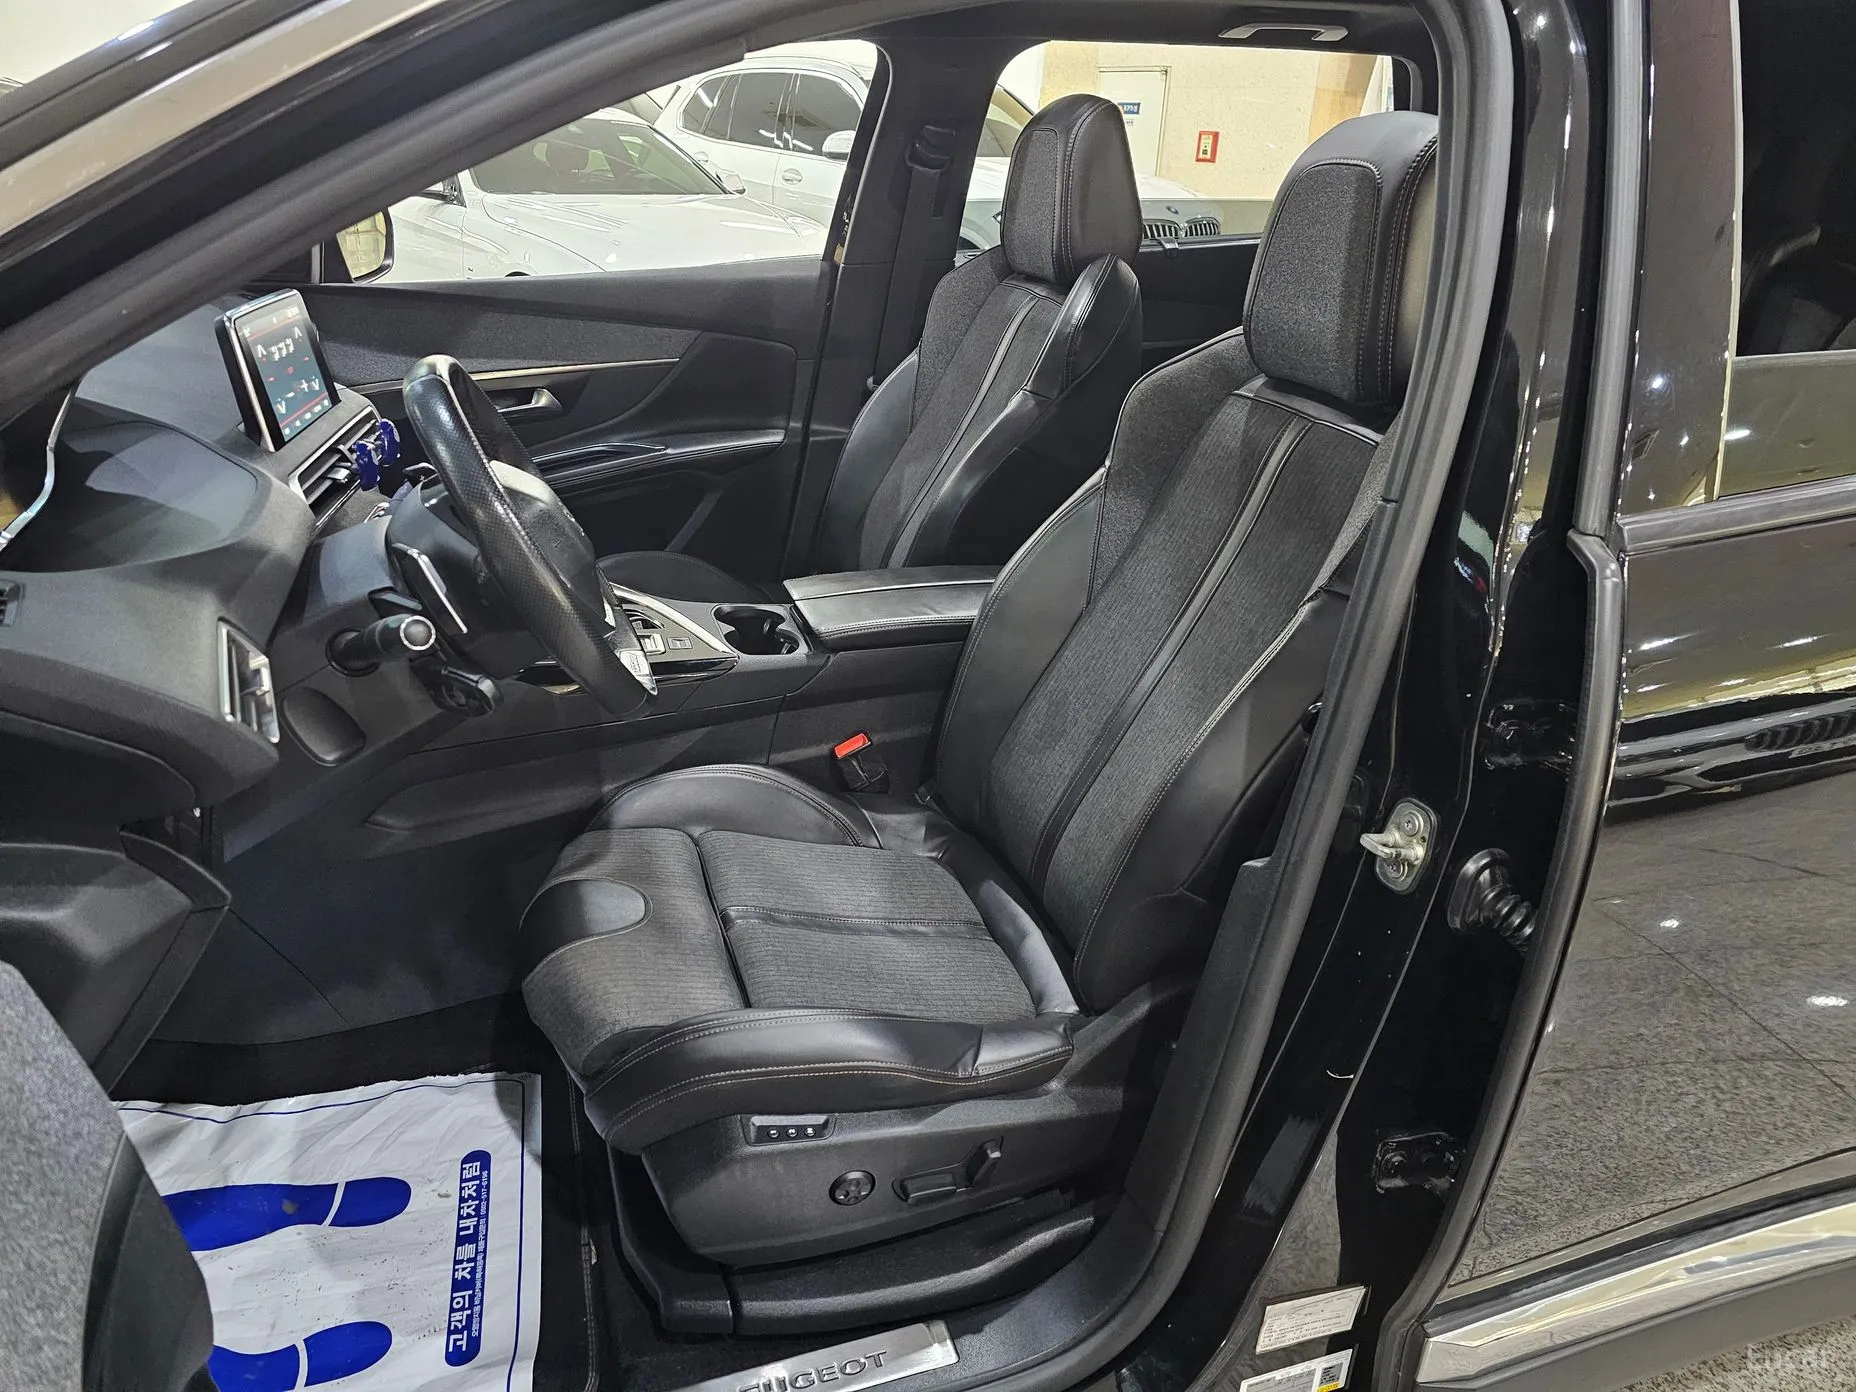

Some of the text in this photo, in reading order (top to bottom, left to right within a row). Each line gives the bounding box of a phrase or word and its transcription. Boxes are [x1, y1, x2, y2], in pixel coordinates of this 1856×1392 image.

[448, 1161, 480, 1352] 고객의 차를 내차처럼
